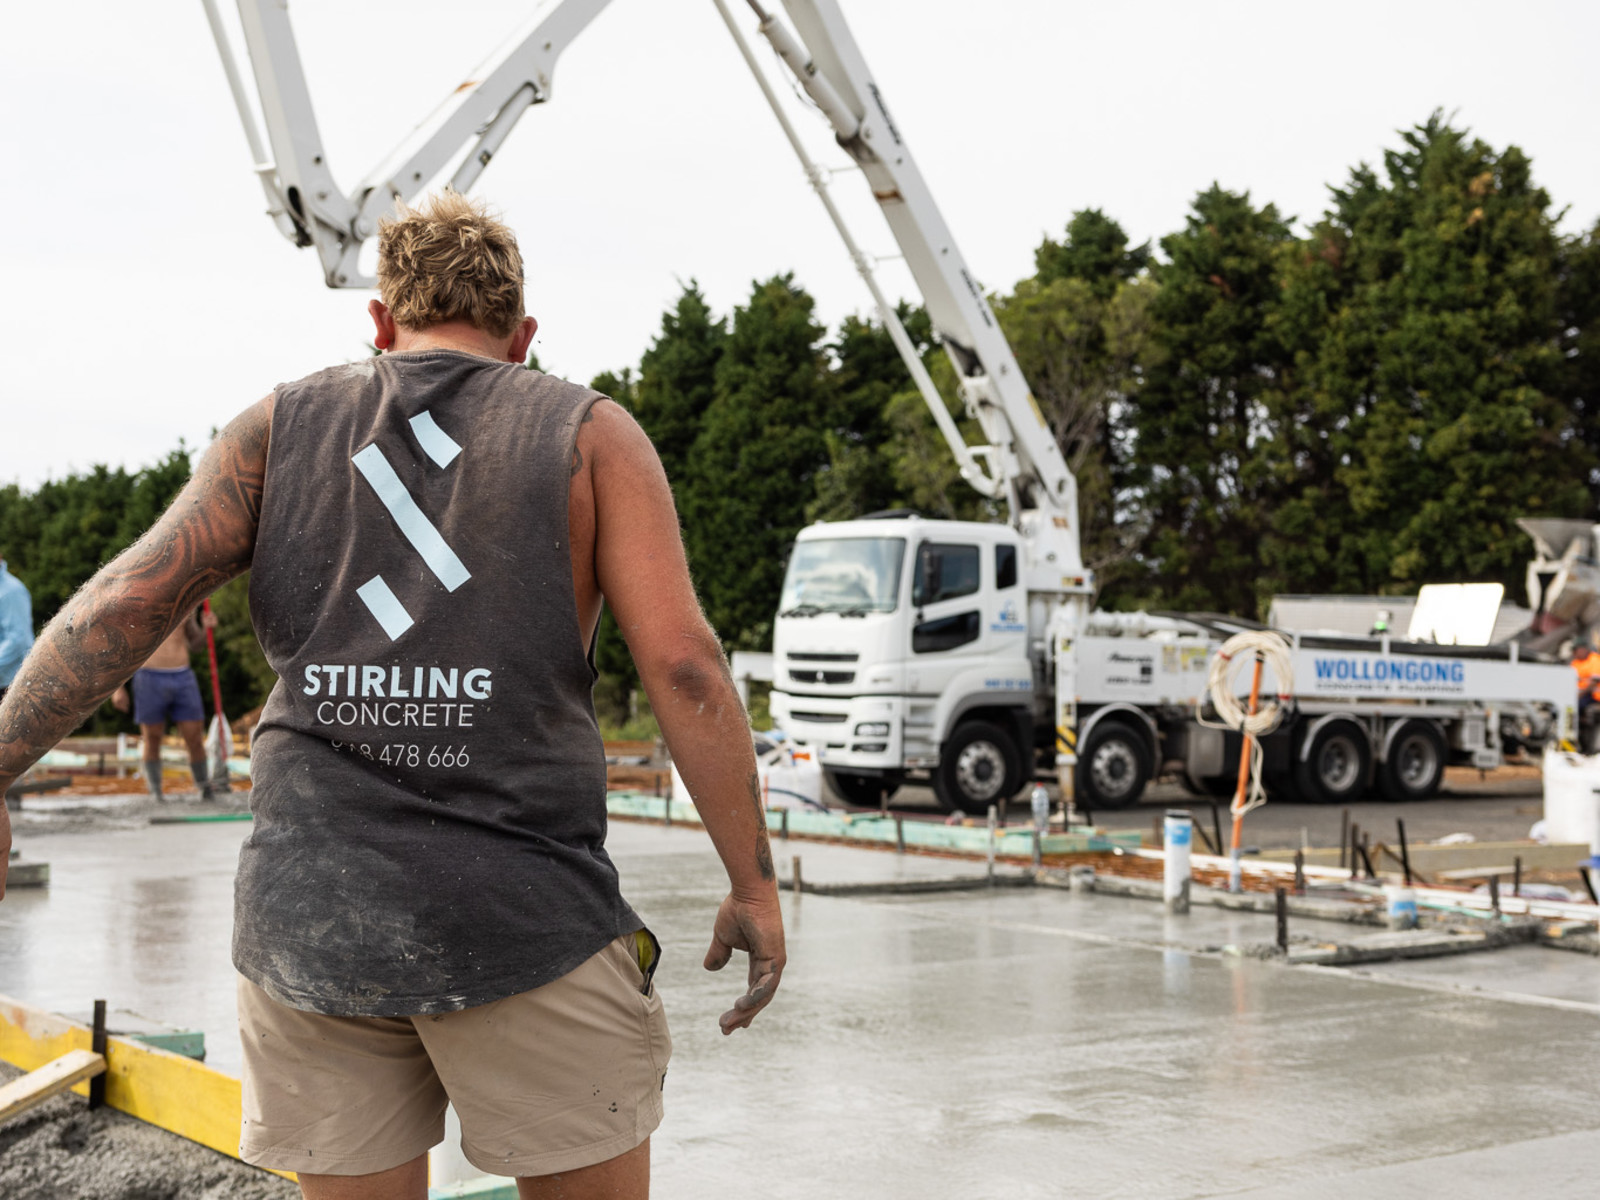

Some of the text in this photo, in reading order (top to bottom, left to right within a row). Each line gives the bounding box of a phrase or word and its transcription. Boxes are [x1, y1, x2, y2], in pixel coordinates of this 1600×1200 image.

[303, 664, 492, 700] STIRLING
[1315, 658, 1464, 682] WOLLONGONG
[317, 701, 474, 727] CONCRETE
[379, 744, 420, 767] 478
[427, 745, 470, 767] 666
